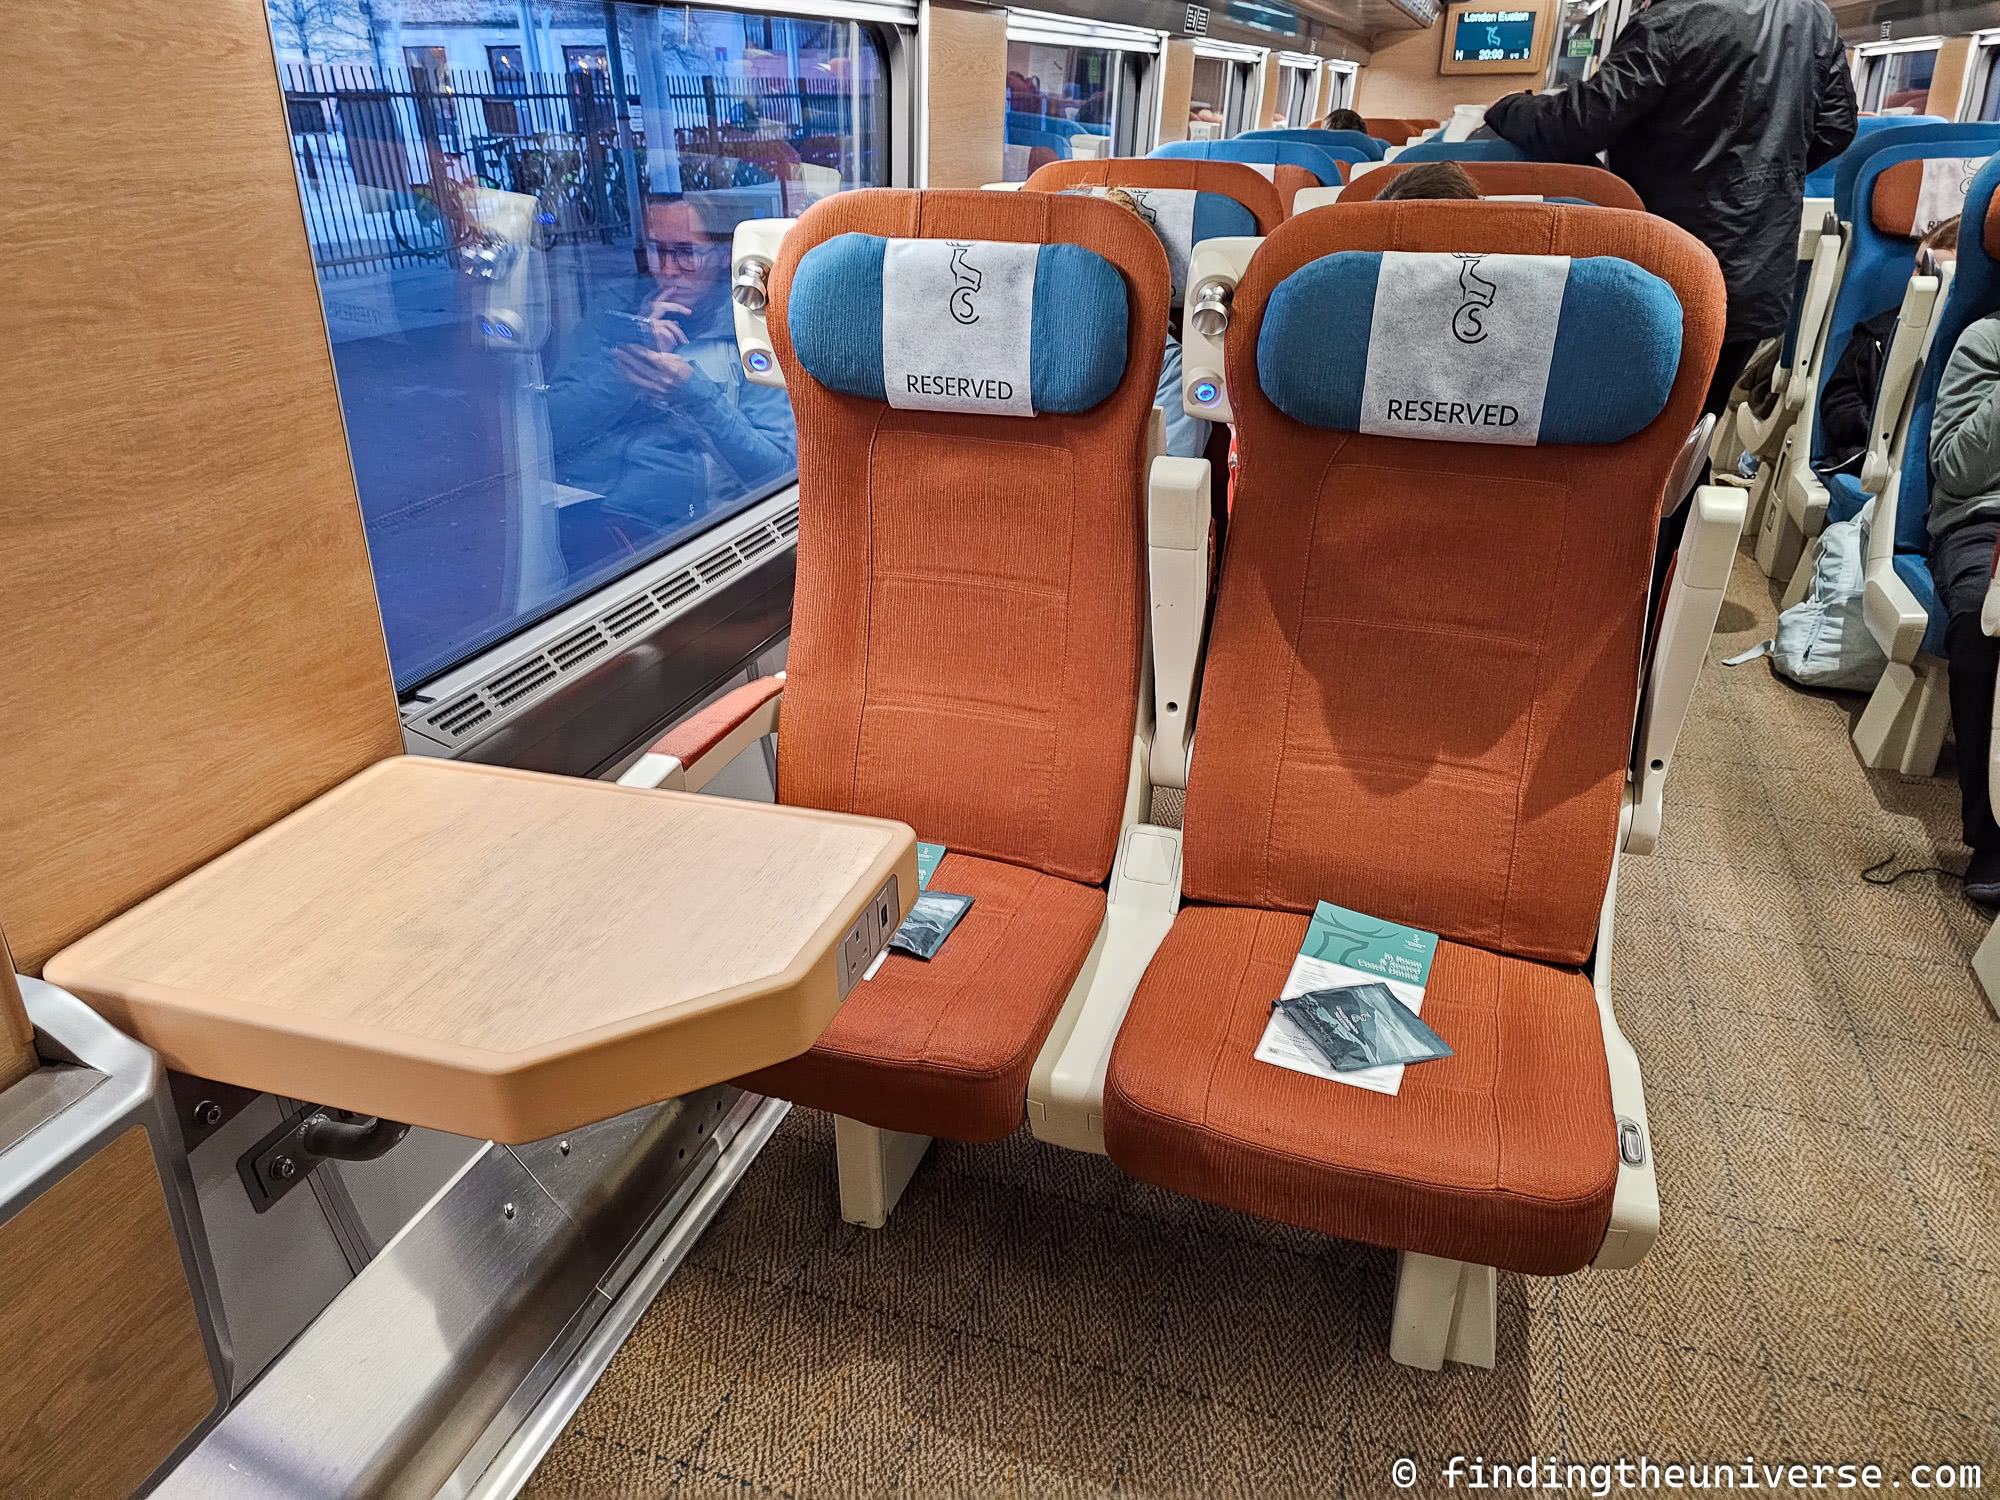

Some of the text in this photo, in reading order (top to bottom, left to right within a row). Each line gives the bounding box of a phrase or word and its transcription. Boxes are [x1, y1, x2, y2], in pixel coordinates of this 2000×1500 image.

[1464, 11, 1529, 23] London Euston
[906, 374, 1013, 400] RESERVED
[1386, 399, 1519, 427] RESERVED
